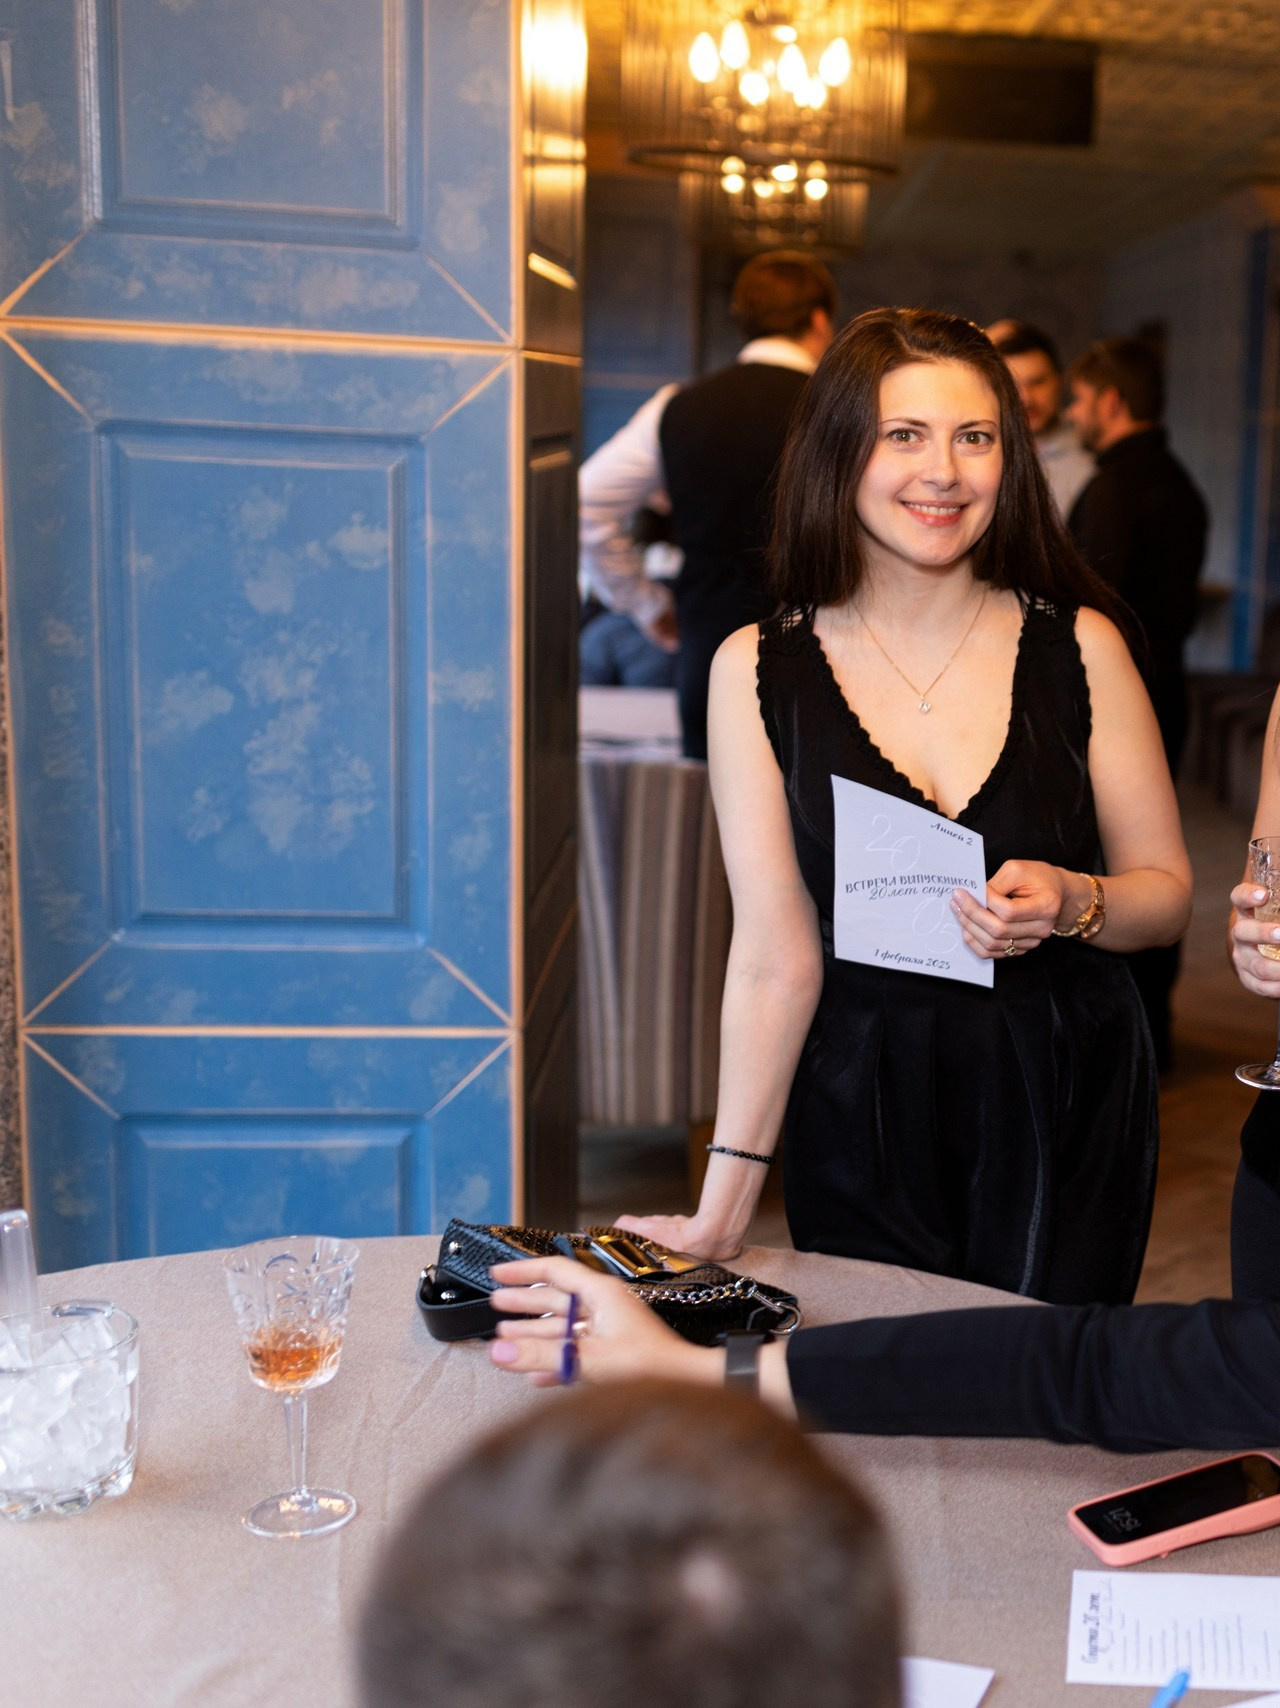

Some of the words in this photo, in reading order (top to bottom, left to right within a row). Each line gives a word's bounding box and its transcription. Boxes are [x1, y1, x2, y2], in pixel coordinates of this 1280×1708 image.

[930, 822, 964, 841] Лицей
[966, 837, 974, 846] 2
[845, 876, 897, 894] ВСТРЕЧА
[899, 873, 978, 890] ВЫПУСКНИКОВ
[868, 886, 887, 901] 20
[888, 886, 919, 899] лет
[921, 884, 955, 899] спус
[881, 950, 924, 964] февраля
[925, 958, 951, 970] 2025
